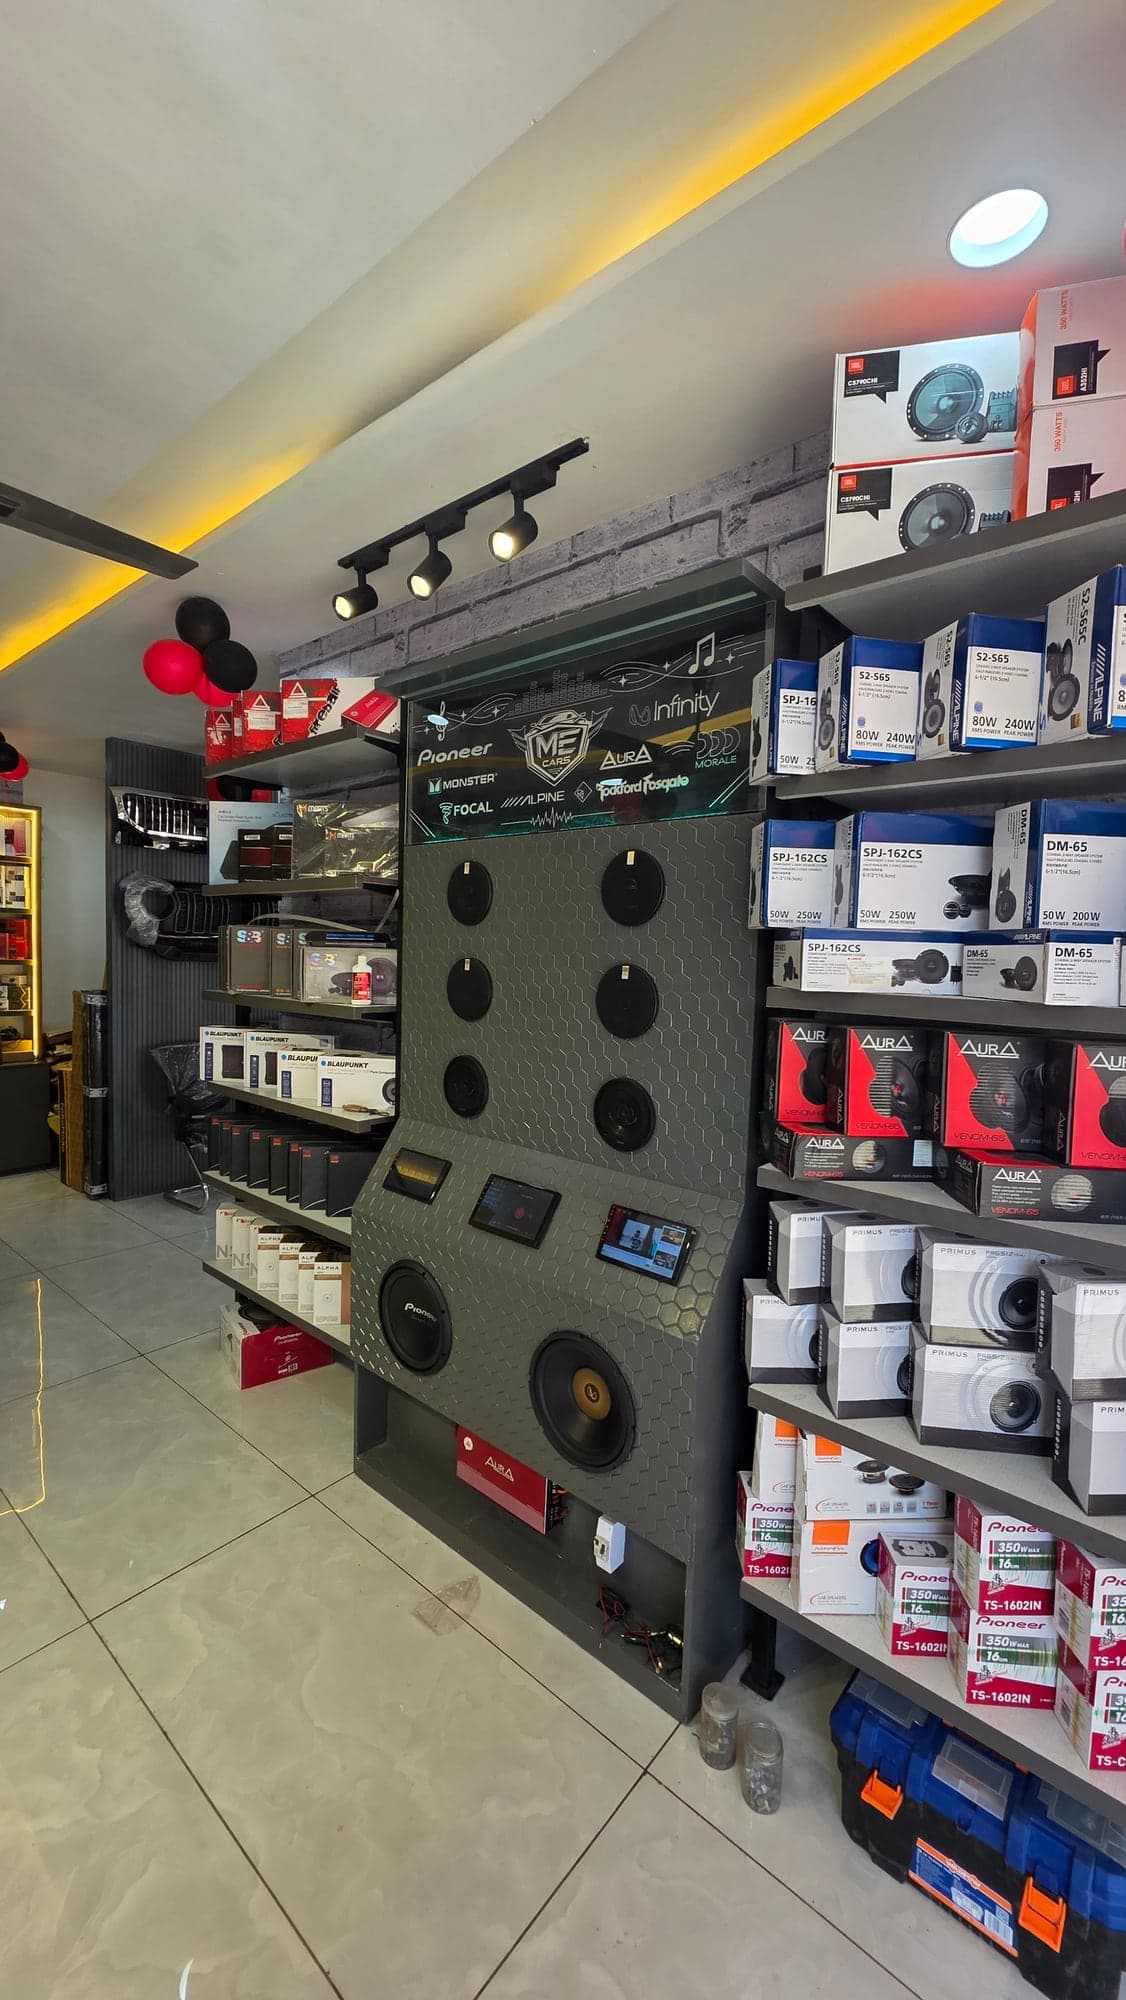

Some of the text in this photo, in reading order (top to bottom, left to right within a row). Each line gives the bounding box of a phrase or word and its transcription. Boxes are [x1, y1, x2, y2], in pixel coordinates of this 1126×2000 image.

[1060, 289, 1068, 315] WATTS
[1054, 412, 1062, 438] WATTS
[1078, 588, 1090, 646] S2-S65C
[976, 652, 1009, 664] S2-S65
[859, 671, 890, 682] S2-S65
[1093, 667, 1105, 722] ALPINE
[654, 690, 720, 721] Infinity
[783, 695, 816, 706] SPJ-16
[972, 716, 1036, 730] 80W 240W
[856, 730, 915, 744] 80W 240W
[417, 743, 492, 766] Pioneer
[536, 728, 581, 757] ME
[542, 756, 571, 768] CARS
[695, 755, 736, 768] MORALE
[780, 755, 816, 766] 50W 25
[443, 774, 495, 790] MONSTER
[454, 801, 494, 816] FOCAL
[1048, 840, 1088, 852] DM-65
[772, 852, 828, 863] SPJ-162CS
[864, 848, 922, 859] SPJ-162CS
[770, 910, 822, 920] 50W 250W
[860, 910, 916, 920] 50W 250W
[1043, 910, 1101, 921] 50W 200W
[808, 944, 860, 952] SPJ-162CS
[1056, 947, 1092, 958] DM-65
[967, 950, 988, 958] DM-65
[790, 1027, 828, 1042] AUR
[860, 1034, 912, 1051] AURA
[958, 1040, 1020, 1058] AURA
[805, 1137, 844, 1150] AURA
[992, 1168, 1041, 1184] AURA
[992, 1207, 1040, 1216] VENOM-65
[940, 1248, 976, 1256] PRIMUS
[932, 1349, 968, 1358] PRIMUS
[485, 1456, 514, 1482] AURA
[752, 1503, 794, 1512] Pione
[988, 1522, 1049, 1532] Pione
[748, 1565, 789, 1574] TS-1602I
[901, 1572, 950, 1582] Pione
[984, 1600, 1042, 1610] TS-1602IN
[1112, 1596, 1126, 1607] 35
[976, 1616, 1046, 1630] Pioneer
[1112, 1614, 1126, 1624] 16
[1094, 1656, 1126, 1666] TS-16
[971, 1690, 1030, 1704] TS-1602IN
[1096, 1755, 1126, 1766] TS-C
